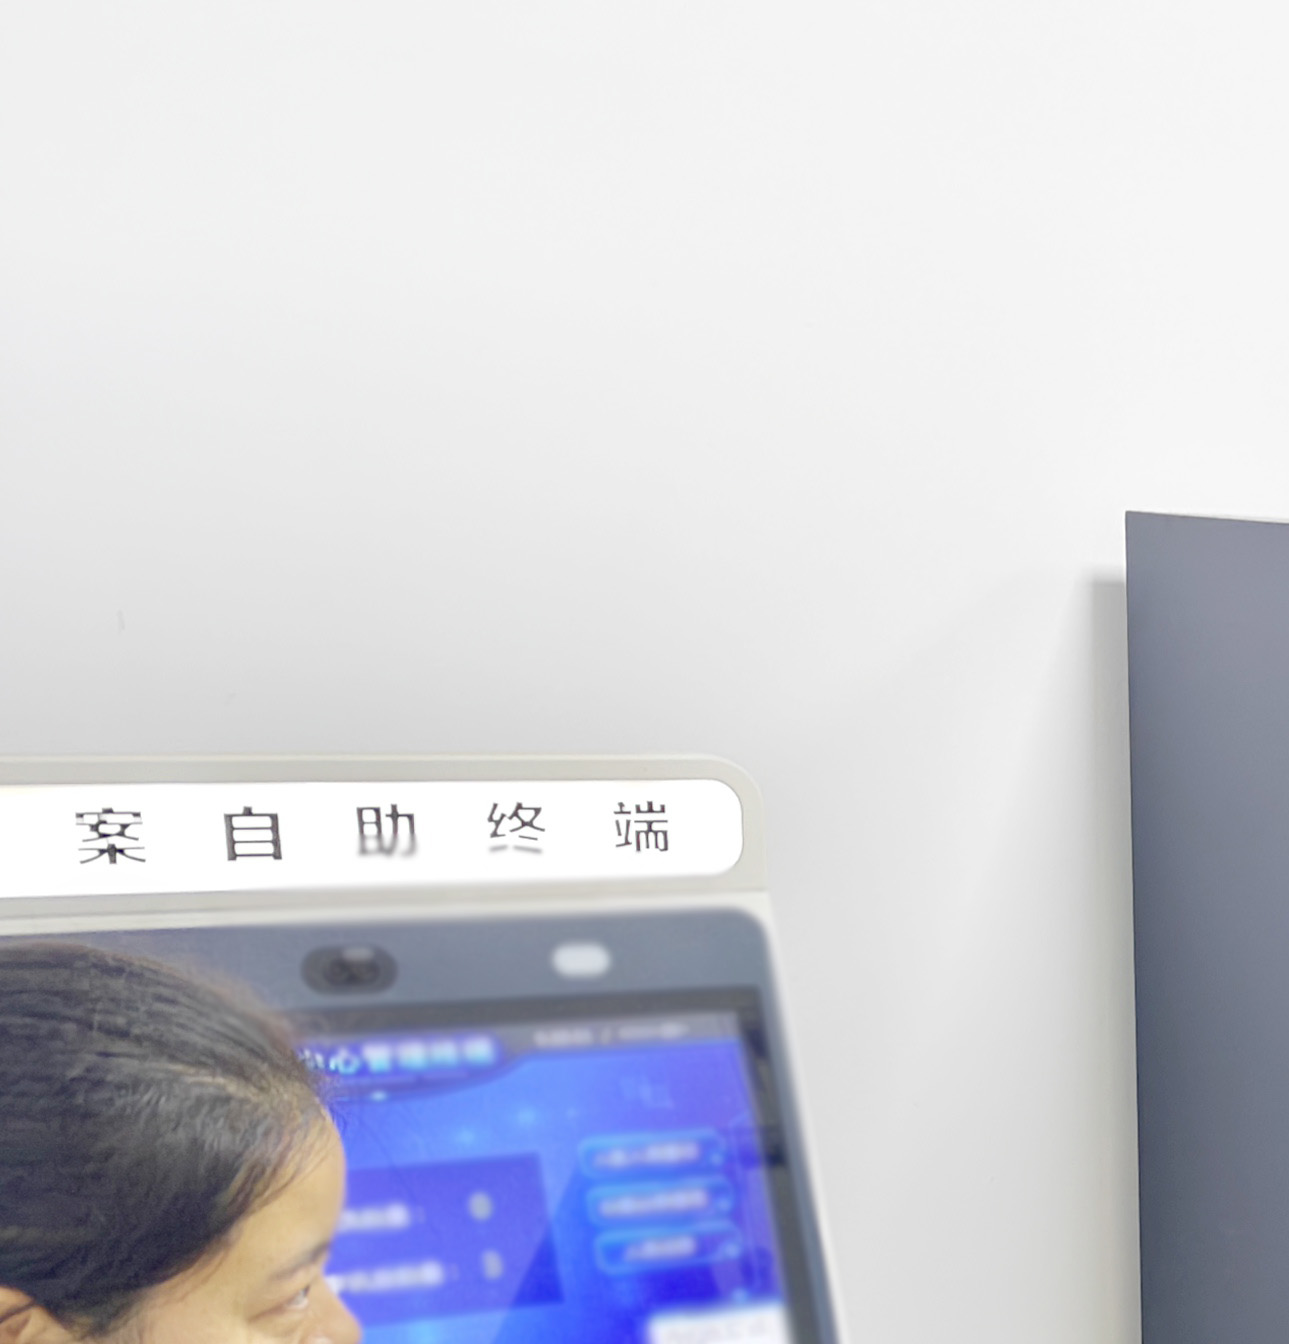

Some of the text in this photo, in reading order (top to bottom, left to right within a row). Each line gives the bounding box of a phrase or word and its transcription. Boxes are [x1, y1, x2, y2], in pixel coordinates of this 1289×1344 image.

[75, 800, 669, 864] 案自助终端
